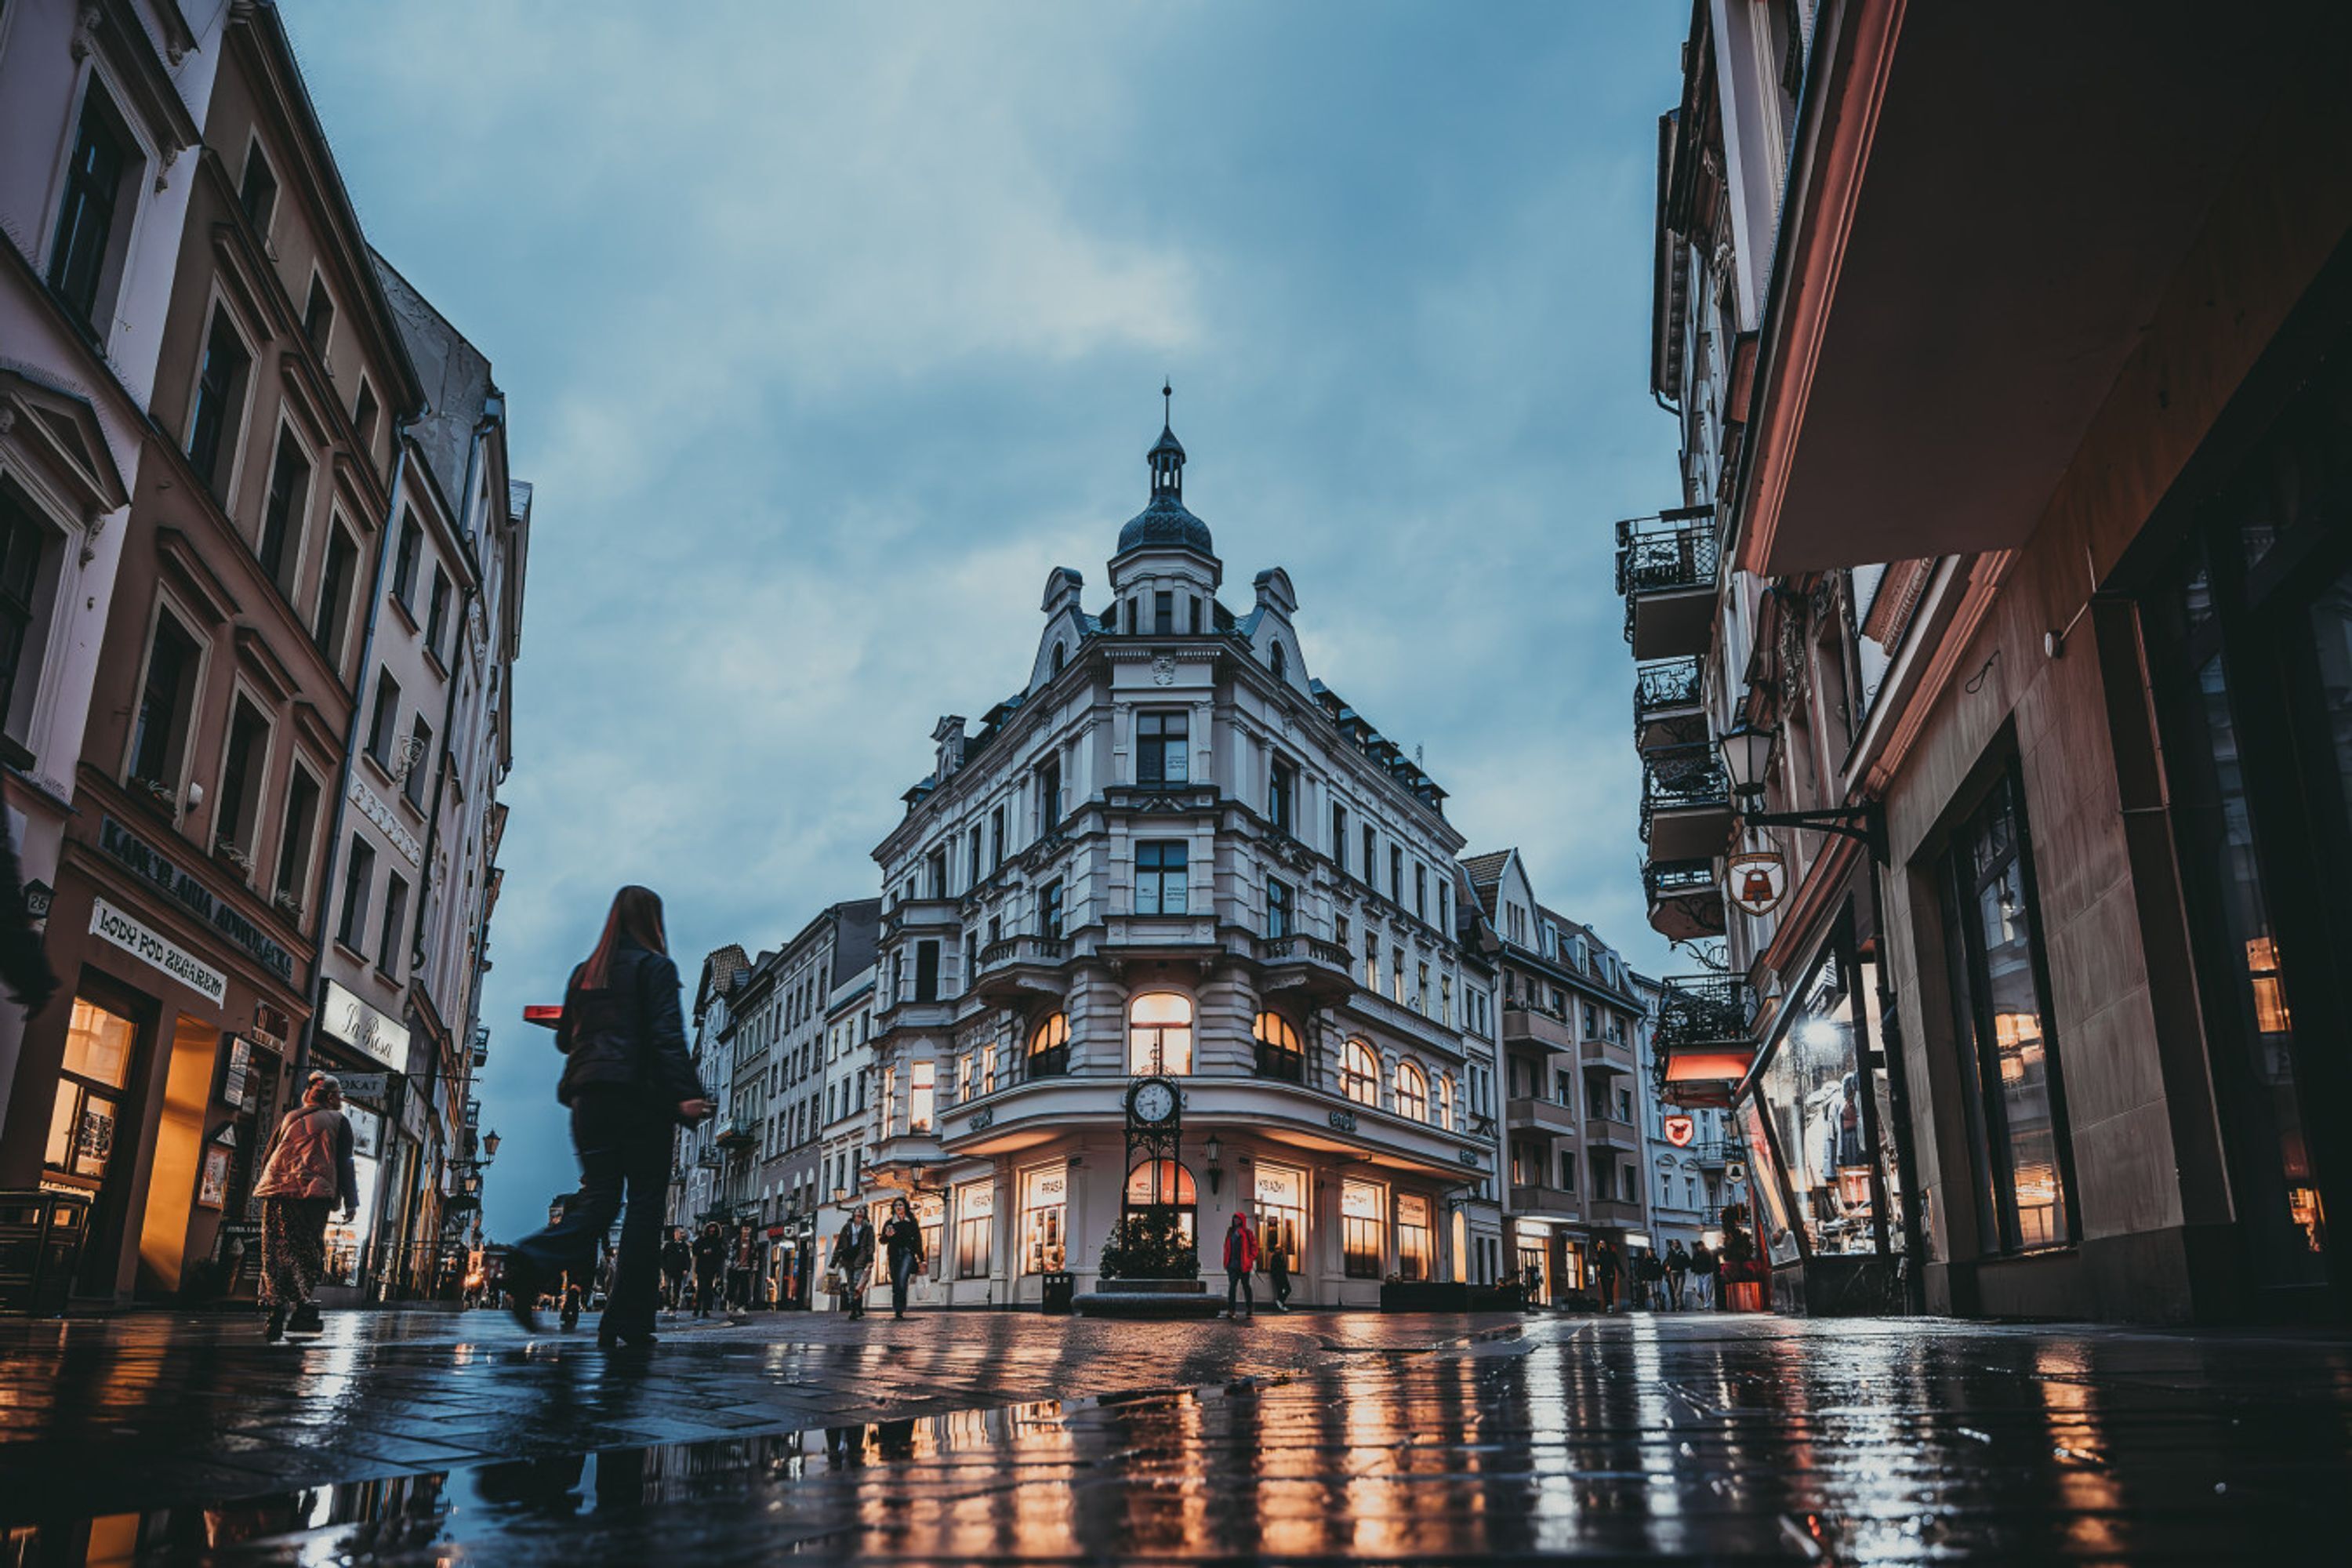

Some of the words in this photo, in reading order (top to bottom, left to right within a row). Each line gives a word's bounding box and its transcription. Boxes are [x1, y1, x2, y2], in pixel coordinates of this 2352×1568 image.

[30, 895, 47, 910] 26
[99, 908, 137, 946] LODY
[138, 932, 163, 962] POD
[164, 949, 223, 996] ZEGAREM
[343, 1003, 360, 1040] La
[362, 1017, 394, 1058] Rosa
